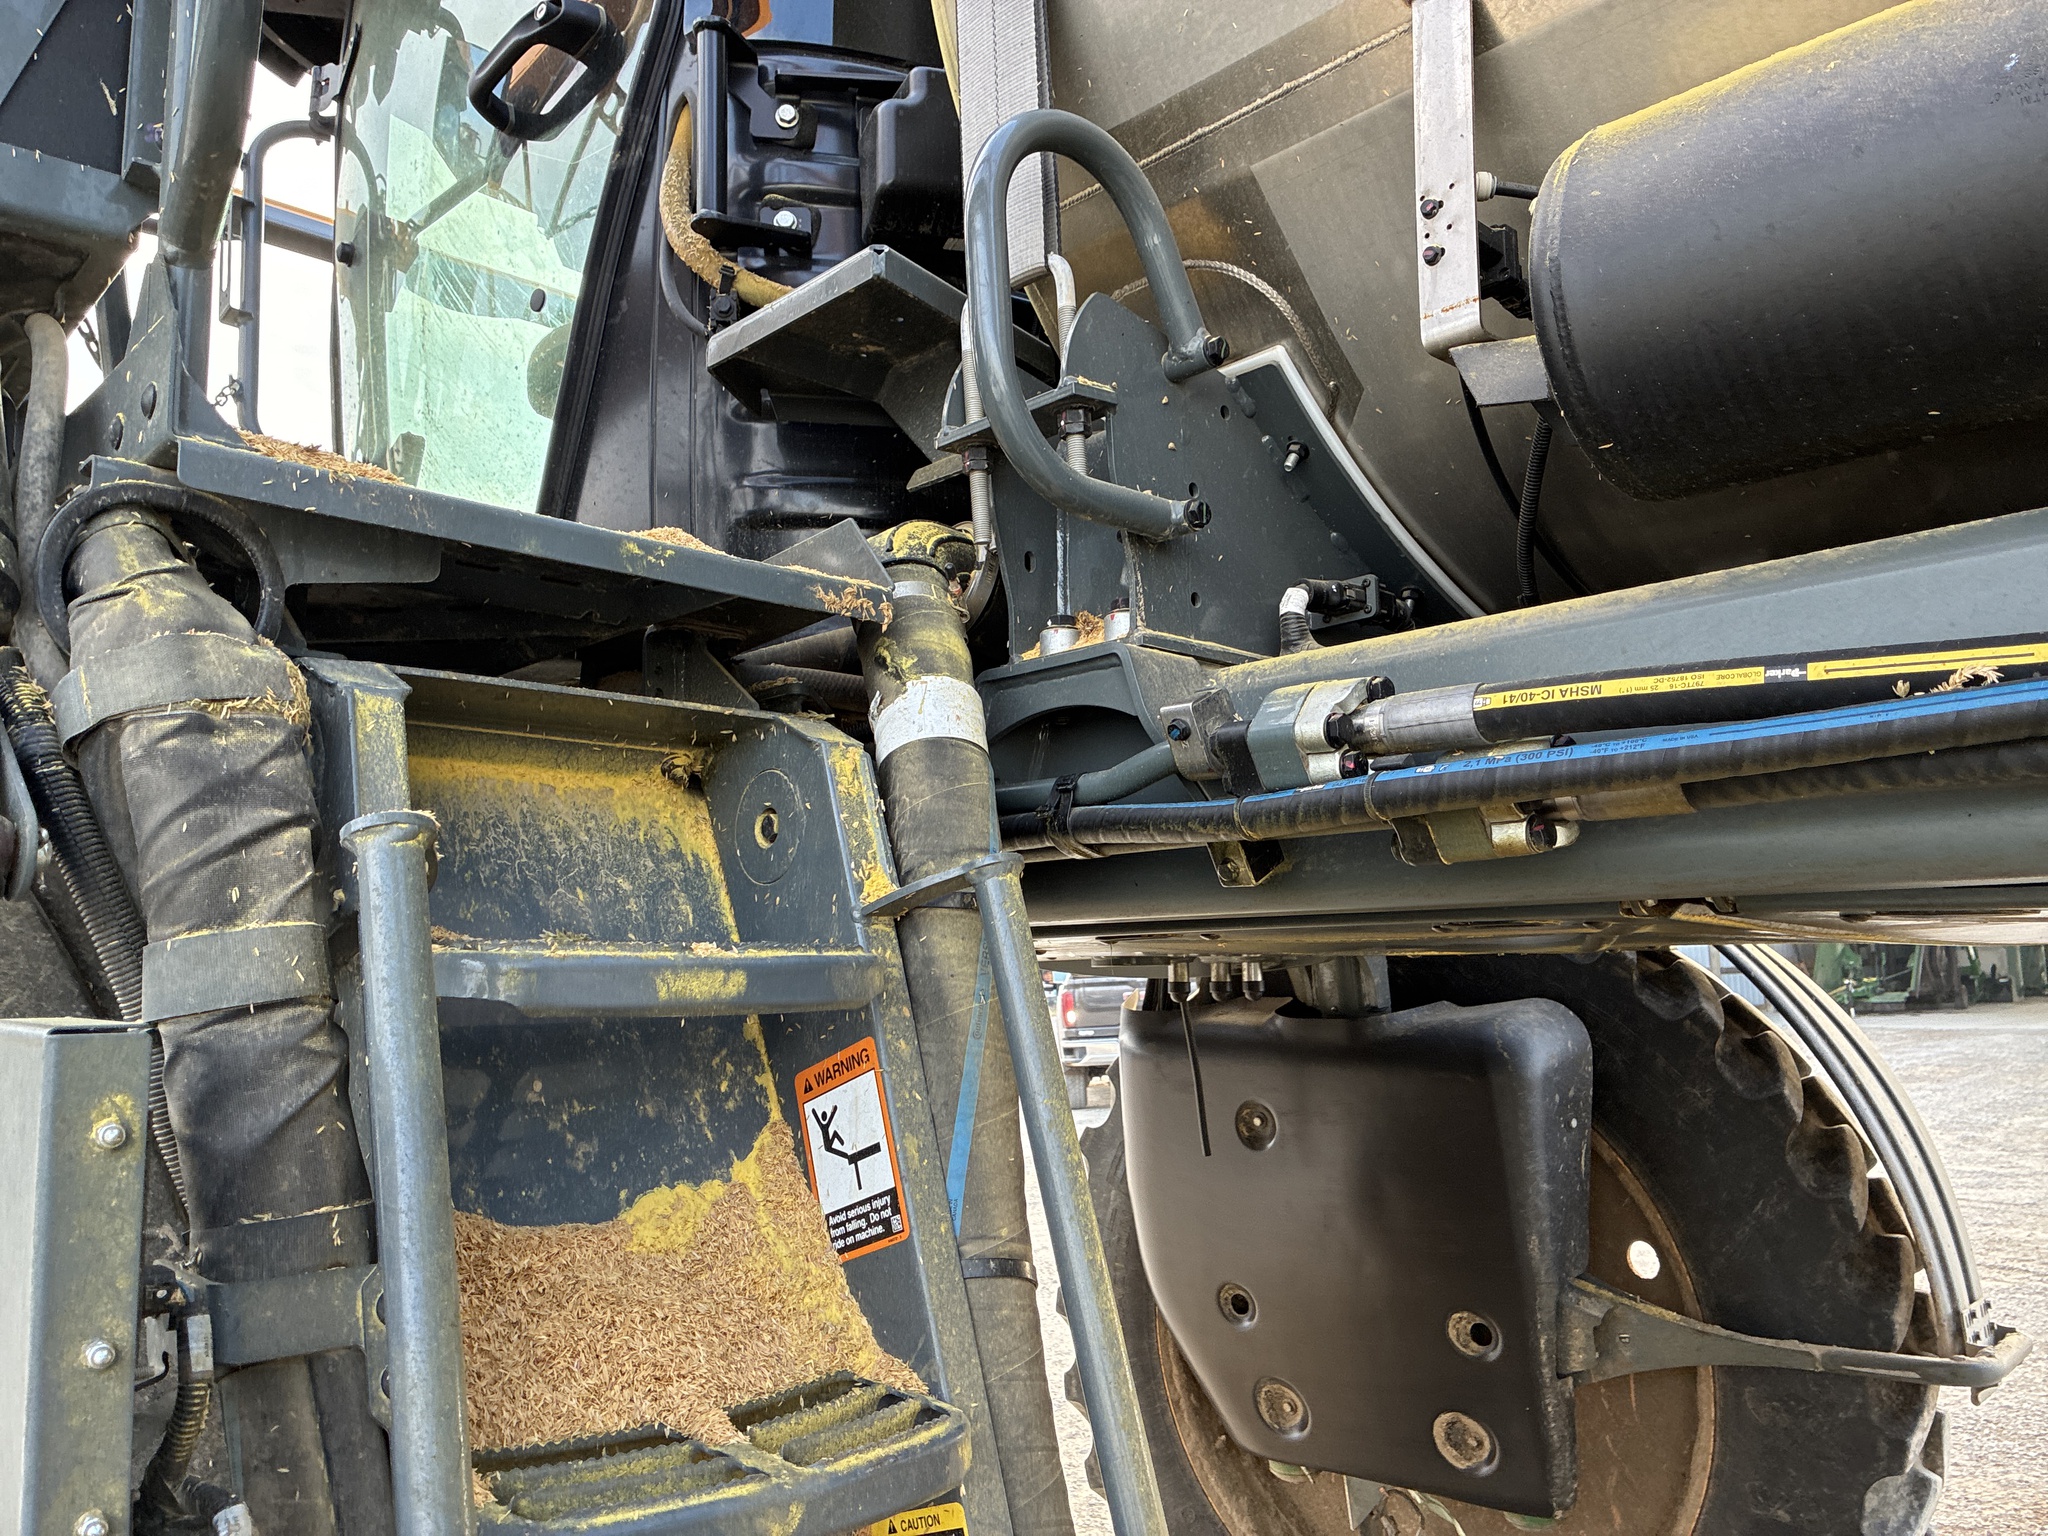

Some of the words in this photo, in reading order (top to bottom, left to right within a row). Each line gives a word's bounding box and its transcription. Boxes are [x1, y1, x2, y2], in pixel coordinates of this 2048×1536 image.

[1653, 675, 1689, 684] 18752-DC
[1690, 673, 1705, 682] ISO
[1716, 670, 1762, 681] GLOBALCORE
[1764, 666, 1806, 679] Parker
[1559, 684, 1602, 699] MSHA
[1669, 680, 1705, 690] 797TC-16
[1502, 689, 1555, 705] IC-40/41
[1462, 758, 1482, 770] 2,1
[1484, 754, 1511, 766] MPa
[1515, 751, 1543, 766] (300
[1546, 747, 1574, 760] PSI)
[813, 1047, 870, 1088] WARNING
[828, 1210, 847, 1227] Avoid
[847, 1202, 872, 1219] serious
[871, 1194, 891, 1209] injury
[951, 1199, 959, 1222] CANADA
[830, 1224, 846, 1238] from
[845, 1217, 868, 1232] falling.
[869, 1212, 880, 1224] Do
[880, 1206, 893, 1219] not
[832, 1237, 846, 1251] ride
[845, 1235, 855, 1244] on
[855, 1224, 886, 1240] machine.
[900, 1513, 941, 1532] CAUTION
